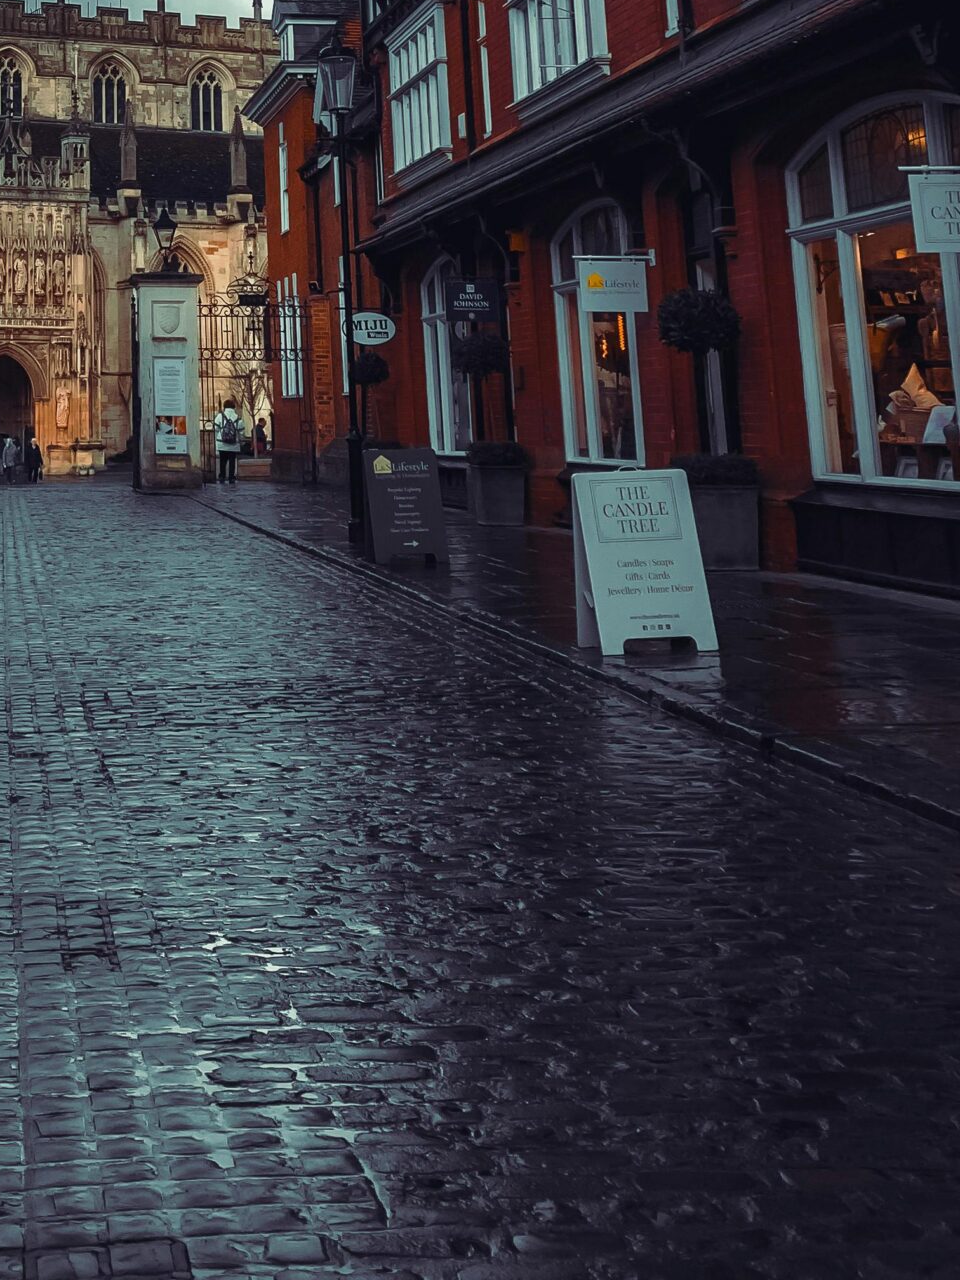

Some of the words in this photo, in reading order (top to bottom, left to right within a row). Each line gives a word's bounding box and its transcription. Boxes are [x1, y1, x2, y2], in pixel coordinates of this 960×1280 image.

[352, 319, 388, 331] MIJU
[392, 461, 429, 473] Lifestyle
[615, 485, 650, 501] THE
[602, 501, 669, 518] CANDLE
[617, 518, 660, 534] TREE
[616, 559, 647, 568] Candles
[652, 559, 674, 568] Soaps
[625, 572, 643, 581] Gifts
[648, 571, 671, 580] Cards
[608, 586, 642, 596] Jewellery
[647, 585, 670, 594] Home
